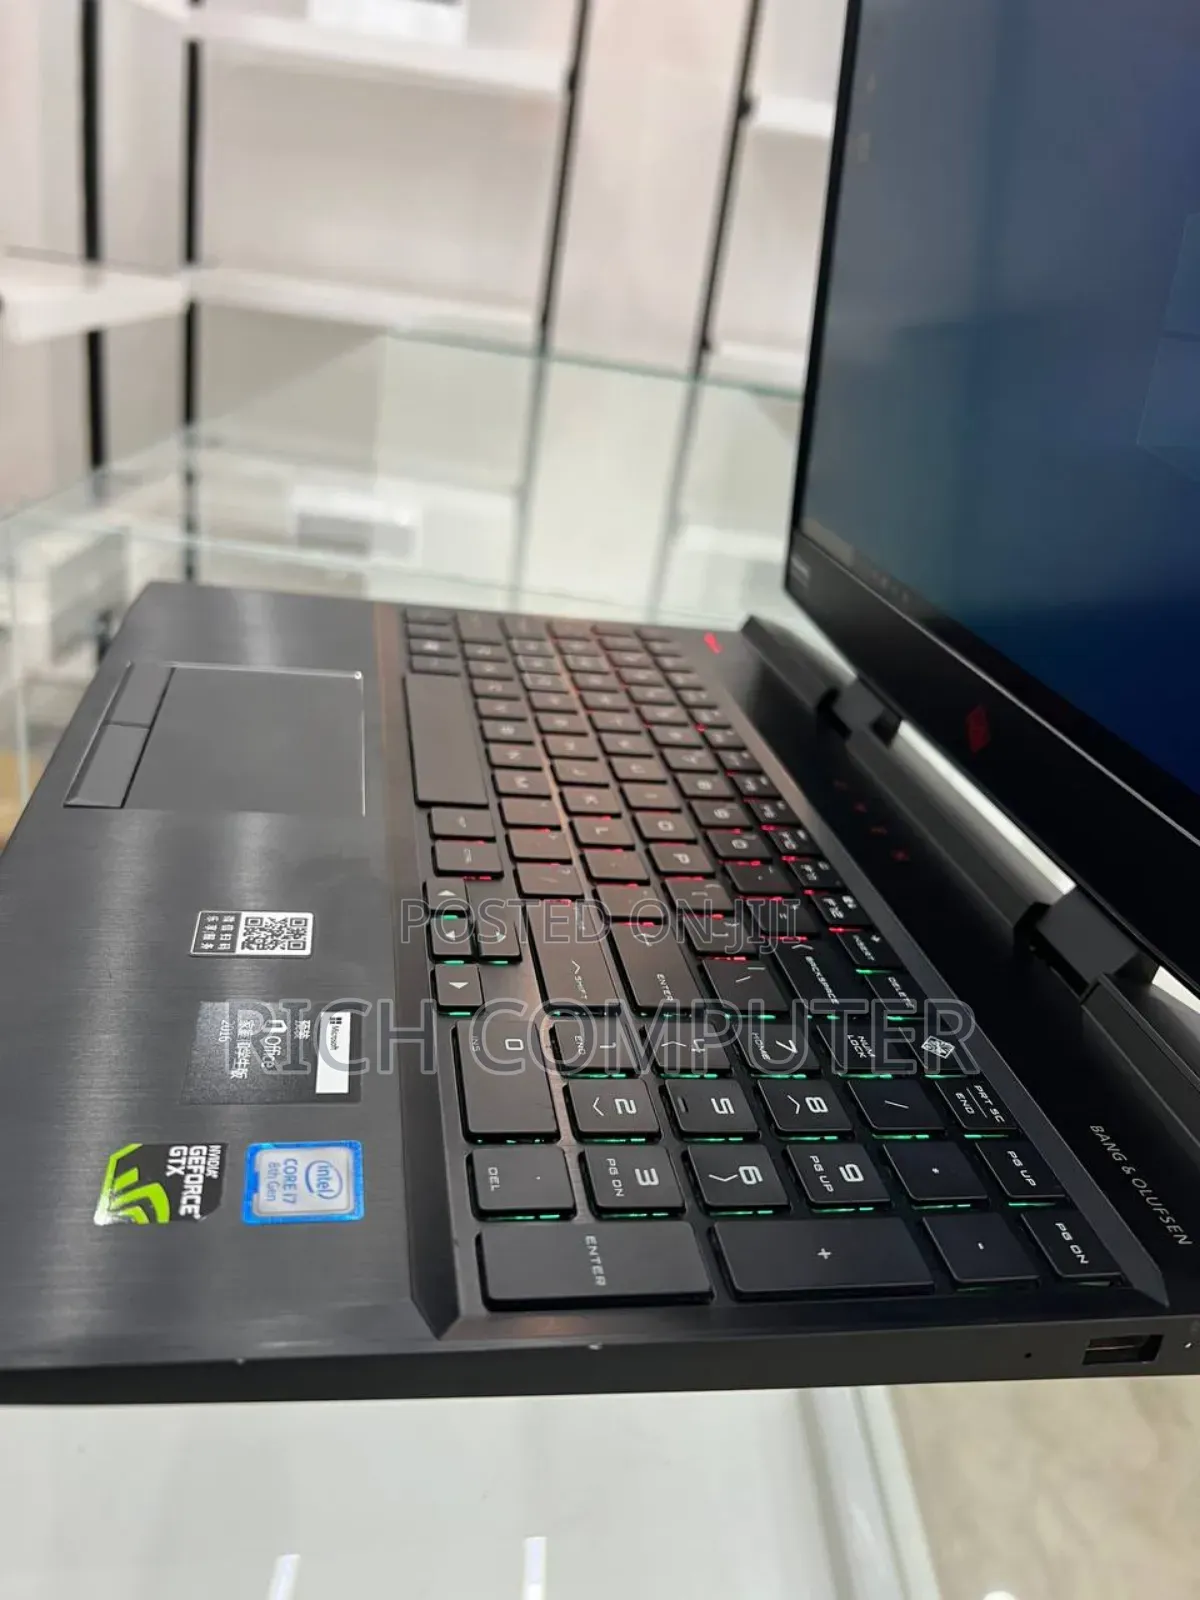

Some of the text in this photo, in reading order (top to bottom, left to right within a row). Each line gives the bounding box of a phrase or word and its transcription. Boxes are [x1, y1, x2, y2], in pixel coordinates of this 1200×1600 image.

[584, 795, 598, 805] K
[714, 808, 730, 819] 9
[673, 852, 690, 864] P
[824, 898, 844, 919] F12
[853, 934, 875, 961] INSERT
[574, 976, 588, 1000] SHIFT
[657, 974, 674, 1002] ENTER
[806, 956, 839, 1004] BACKSPACE
[218, 1020, 231, 1043] 2016
[330, 1025, 339, 1050] Microsoft
[260, 1036, 282, 1069] Office
[504, 1039, 524, 1050] 0
[691, 1039, 706, 1053] 4
[776, 1040, 797, 1053] 7
[847, 1035, 866, 1058] LOCK
[858, 1035, 876, 1057] NUM
[615, 1098, 636, 1114] 2
[711, 1098, 734, 1114] 5
[805, 1096, 828, 1114] 8
[955, 1092, 974, 1114] END
[974, 1085, 1005, 1123] PRT SC
[166, 1145, 188, 1178] GTX
[606, 1158, 618, 1174] PG
[1007, 1150, 1036, 1187] PG UP
[264, 1162, 280, 1202] 8th Gen
[282, 1158, 298, 1190] CORE
[315, 1163, 332, 1194] intel
[635, 1168, 659, 1186] 3
[739, 1165, 764, 1185] 6
[810, 1155, 833, 1193] PG UP
[839, 1164, 864, 1182] 9
[1090, 1124, 1193, 1246] BANG & OLUFSEN
[1055, 1222, 1071, 1241] PG
[586, 1236, 606, 1286] ENTER
